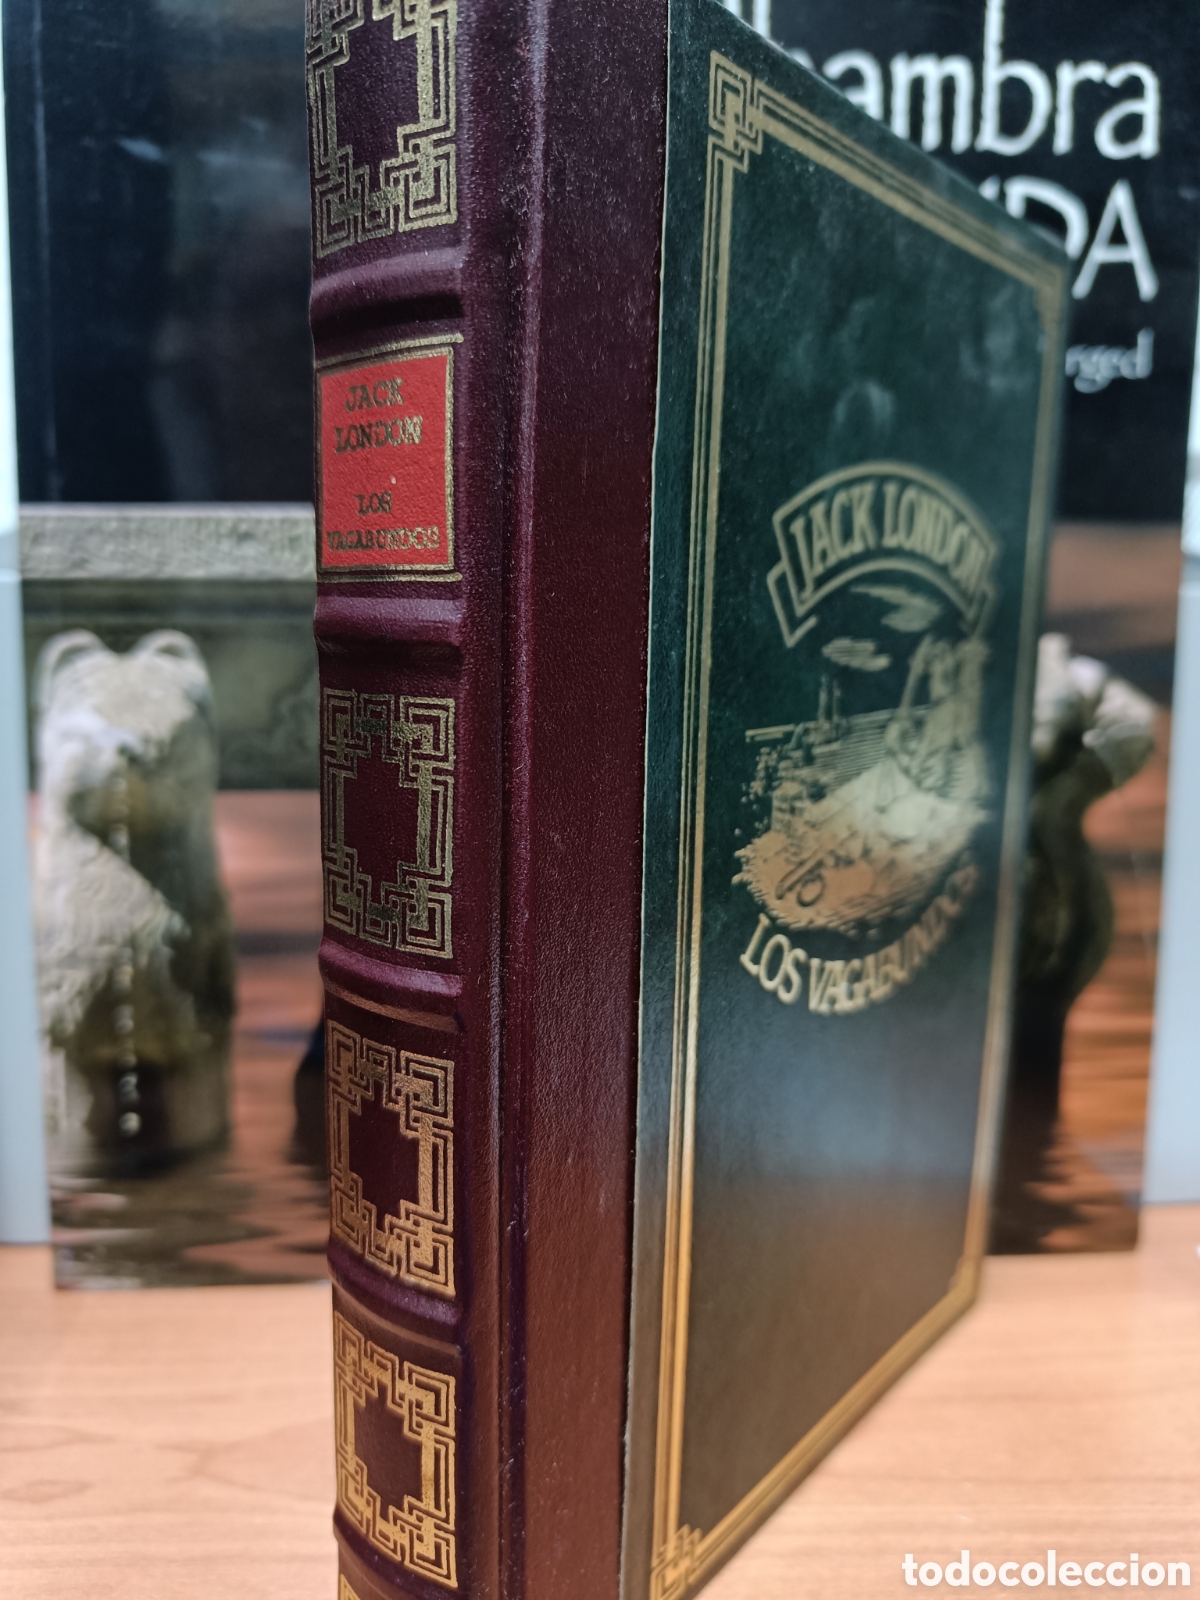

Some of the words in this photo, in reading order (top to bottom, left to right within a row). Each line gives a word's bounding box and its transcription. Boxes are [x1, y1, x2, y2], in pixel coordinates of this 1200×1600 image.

[722, 0, 1160, 159] ambra
[345, 377, 403, 413] JACK
[335, 415, 423, 454] LONDON
[354, 491, 393, 516] LOS
[790, 480, 878, 599] JACK
[882, 480, 988, 595] LONDON
[740, 912, 808, 1005] LOS
